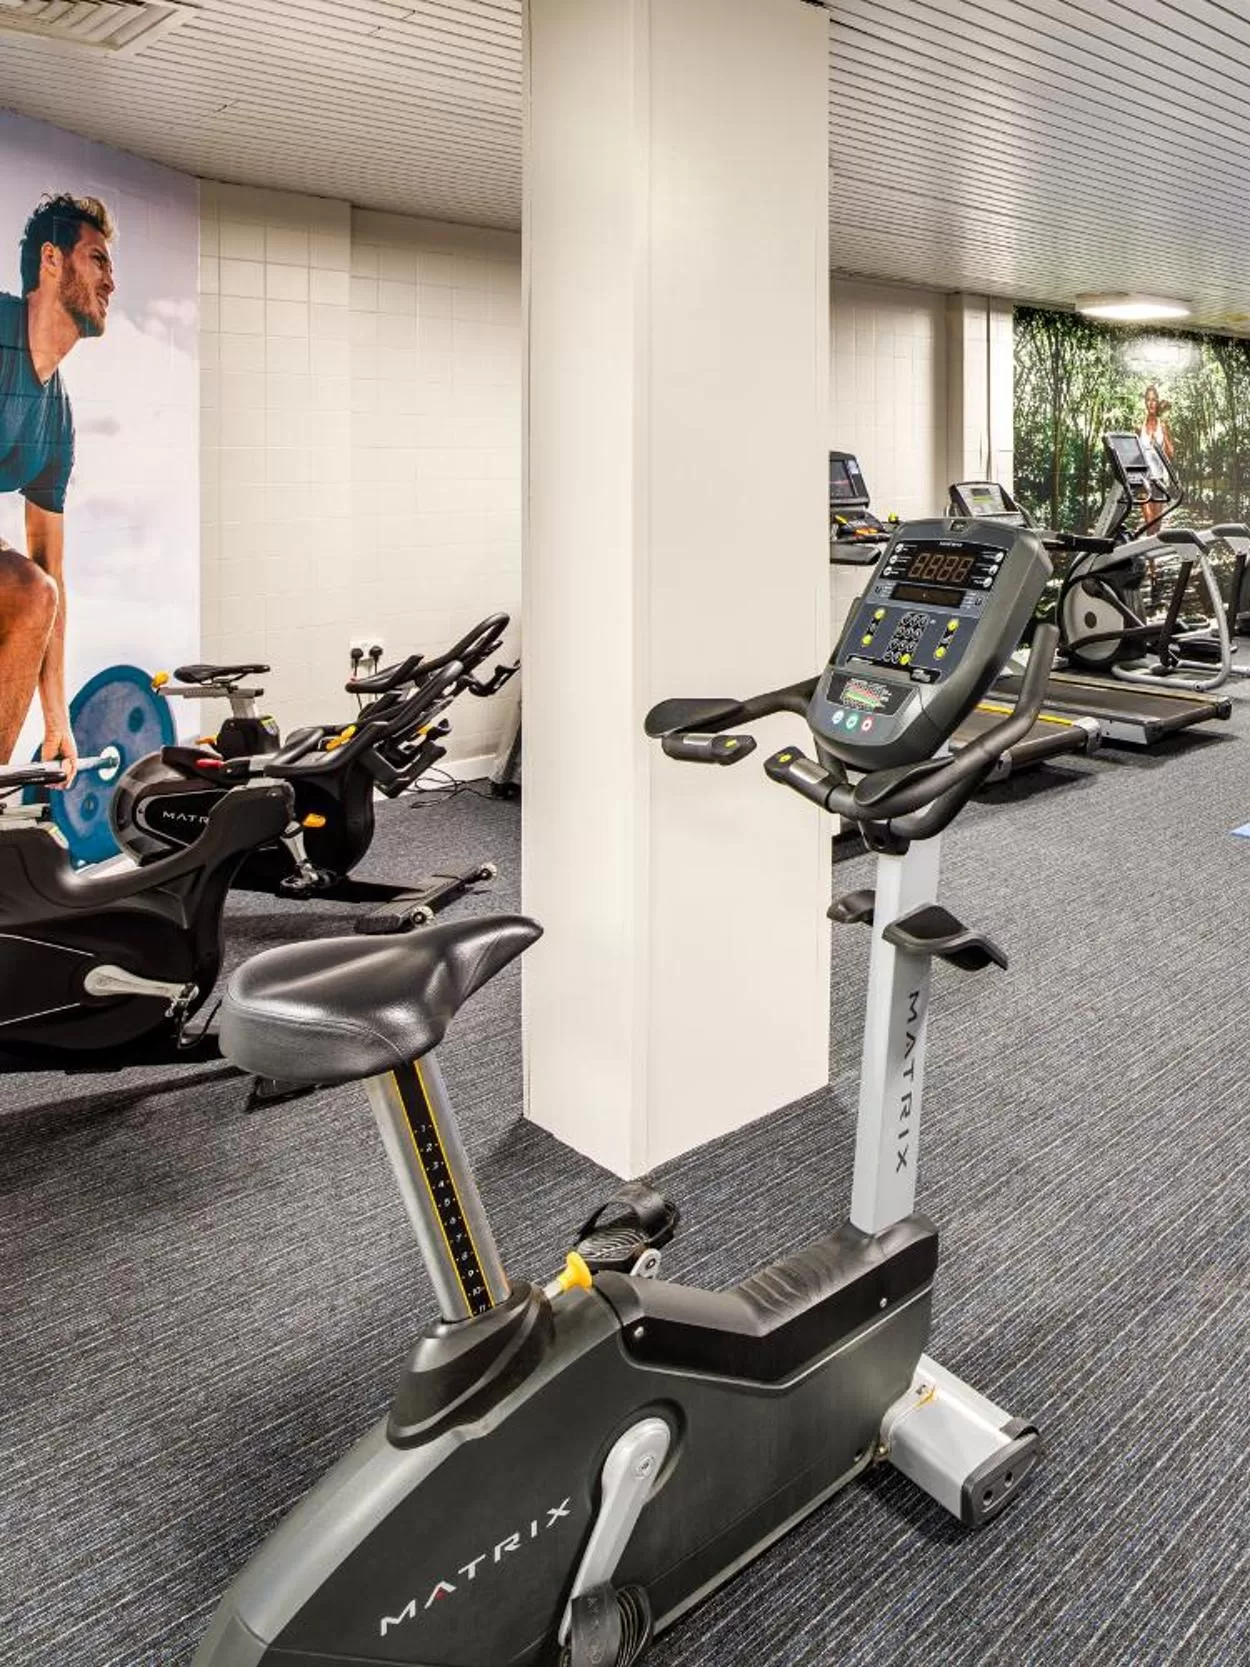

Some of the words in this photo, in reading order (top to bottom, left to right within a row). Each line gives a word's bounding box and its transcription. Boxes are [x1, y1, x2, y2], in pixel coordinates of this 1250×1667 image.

[162, 810, 210, 824] MATR
[896, 990, 919, 1173] MATRIX
[380, 1497, 571, 1636] MATRIX
